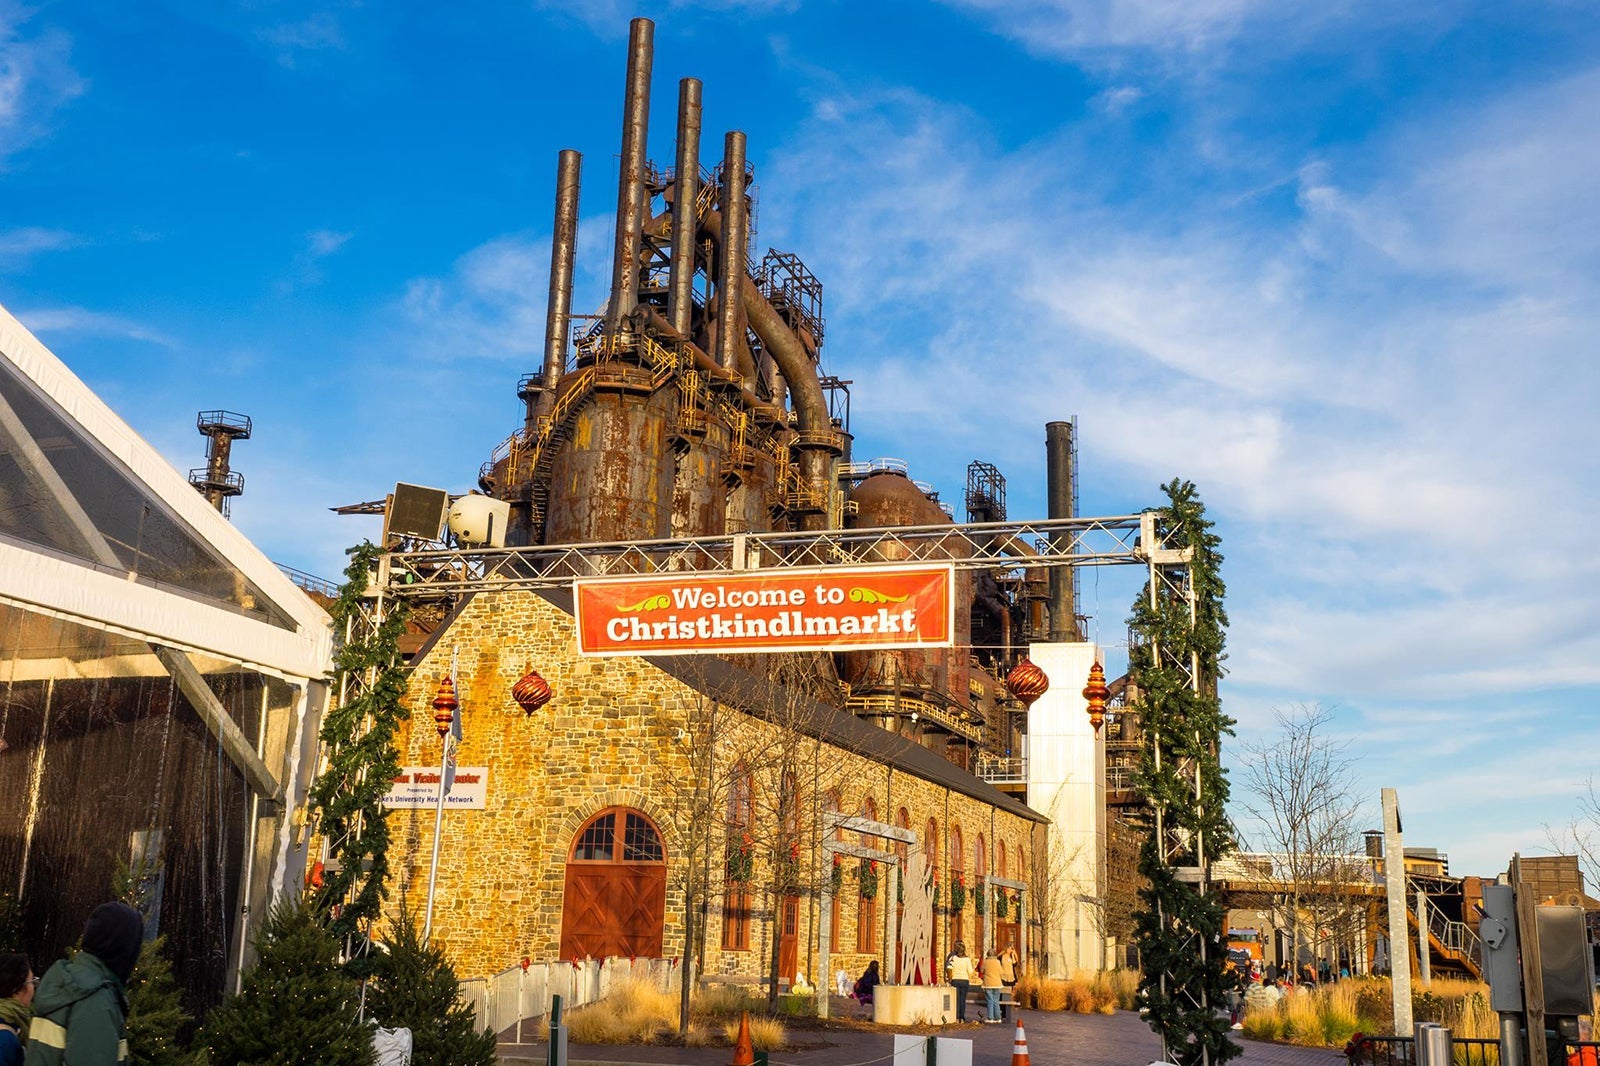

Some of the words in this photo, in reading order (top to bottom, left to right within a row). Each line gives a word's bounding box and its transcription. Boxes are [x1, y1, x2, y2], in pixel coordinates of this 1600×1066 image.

[671, 586, 808, 611] Welcome
[815, 584, 846, 606] to
[605, 608, 917, 643] Christkindlmarkt
[413, 772, 441, 784] Visito
[454, 773, 480, 784] enter
[395, 796, 425, 804] University
